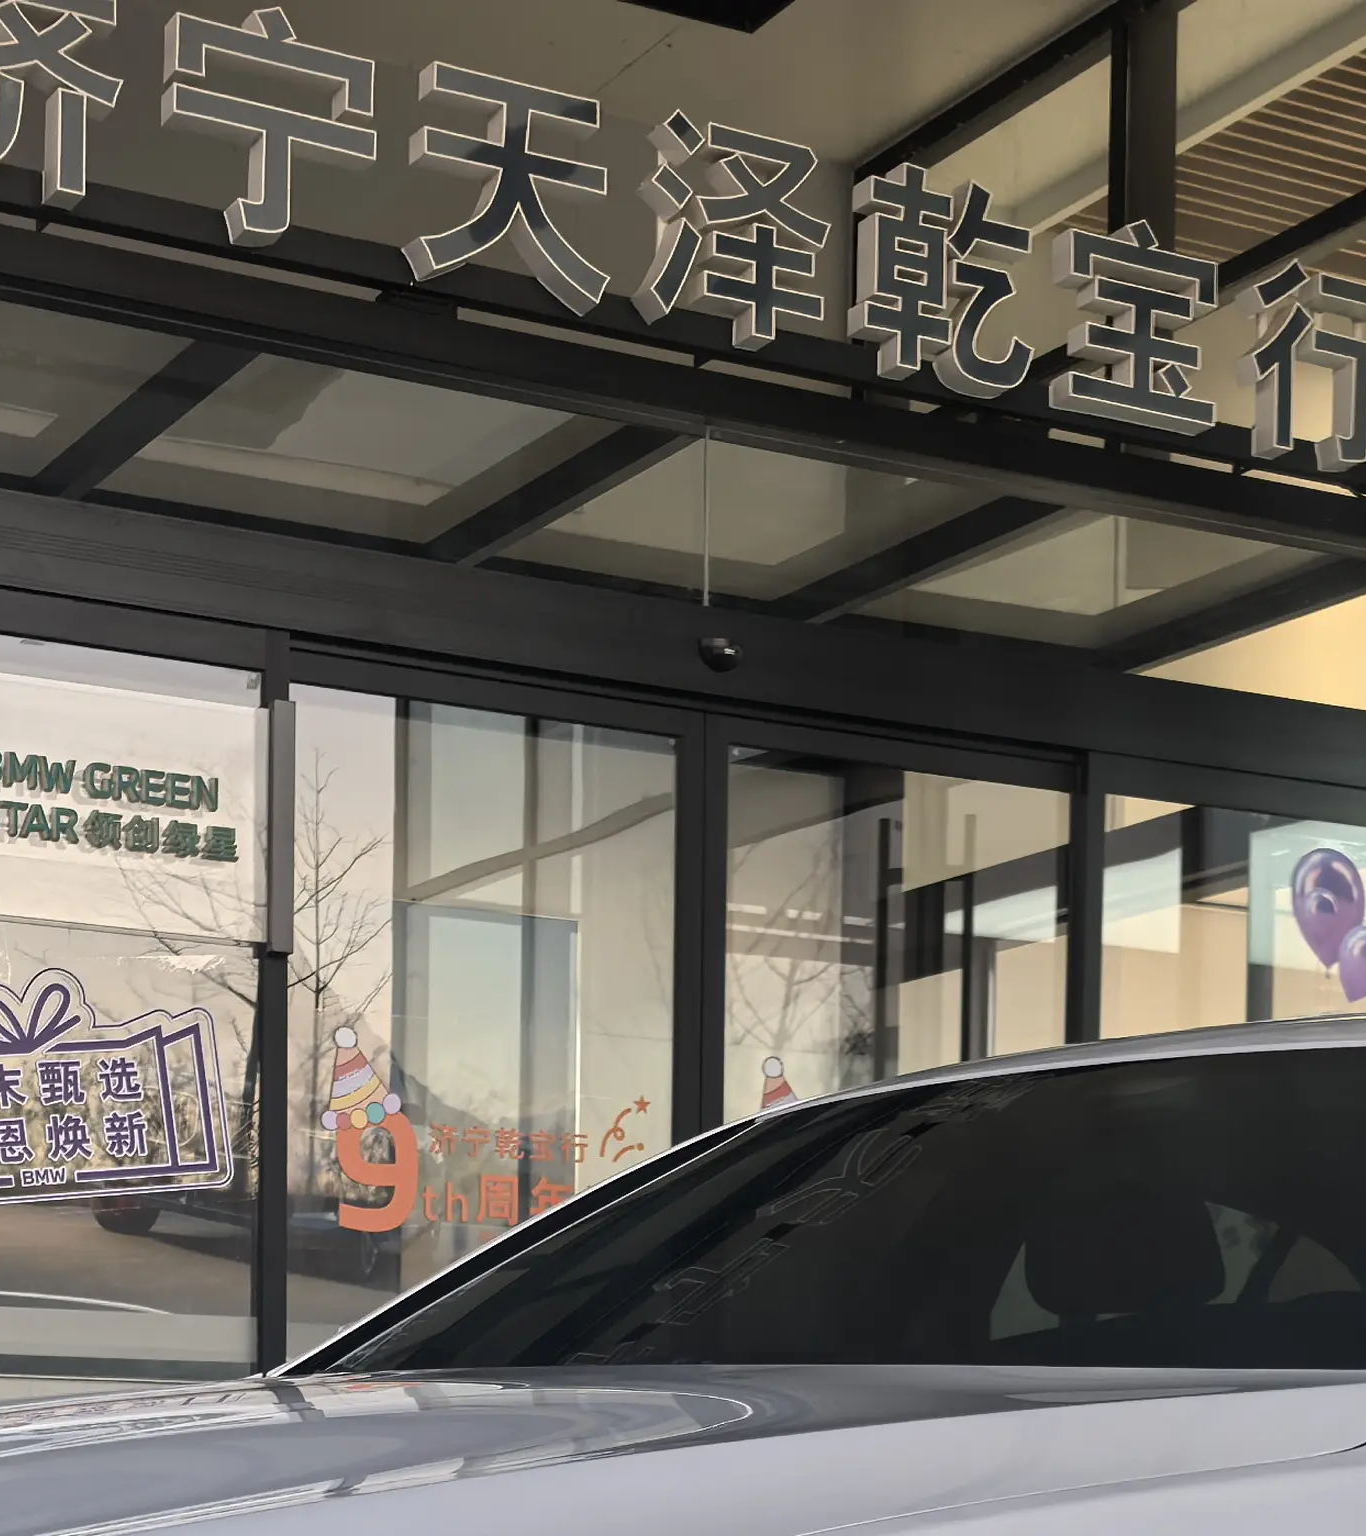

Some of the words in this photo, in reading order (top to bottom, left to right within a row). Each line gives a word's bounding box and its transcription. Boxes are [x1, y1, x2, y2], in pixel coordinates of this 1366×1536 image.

[83, 762, 219, 812] GREEN
[84, 809, 239, 863] 领创绿星
[428, 1124, 588, 1164] 济宁乾宝行
[21, 1167, 67, 1188] BMW
